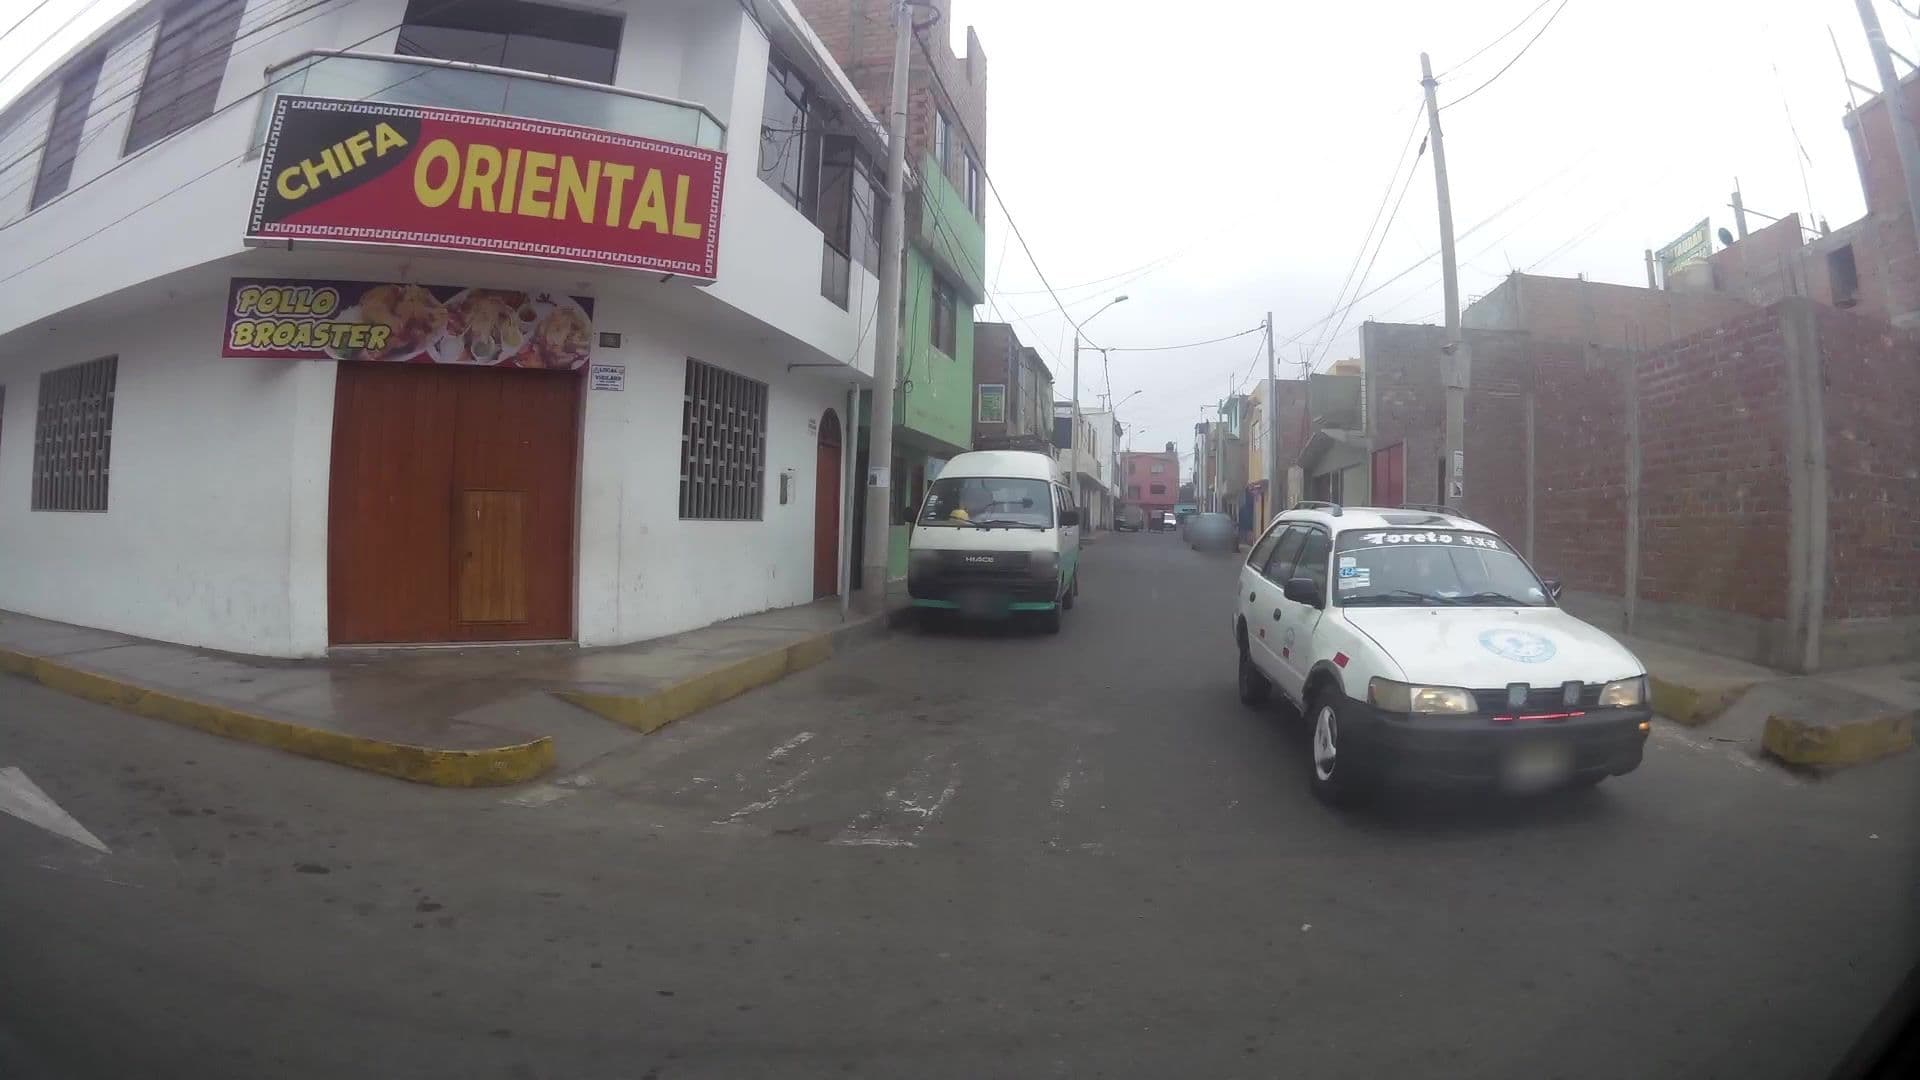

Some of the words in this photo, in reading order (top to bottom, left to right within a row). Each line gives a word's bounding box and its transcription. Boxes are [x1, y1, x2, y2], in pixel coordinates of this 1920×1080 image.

[276, 121, 408, 201] CHIFA
[413, 138, 702, 240] ORIENTAL
[236, 287, 338, 316] POLLO
[231, 320, 392, 350] BROASTER
[1361, 532, 1453, 545] Toreto
